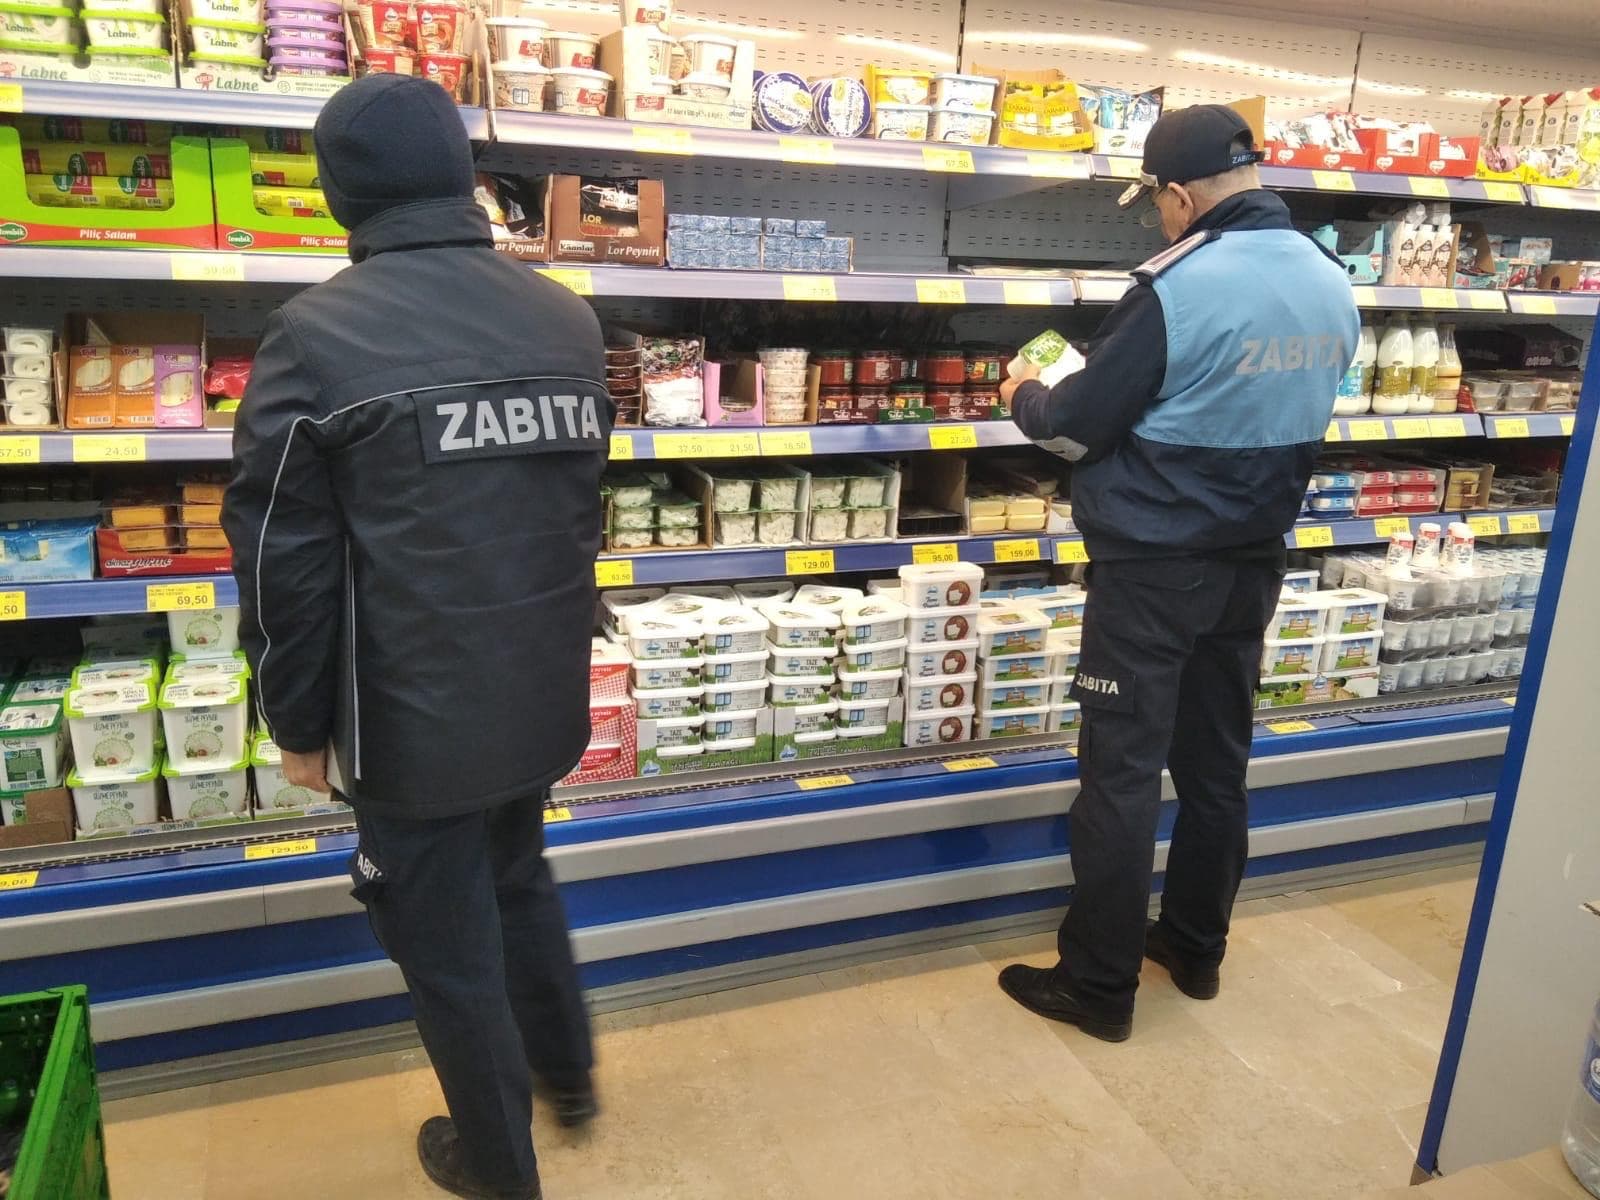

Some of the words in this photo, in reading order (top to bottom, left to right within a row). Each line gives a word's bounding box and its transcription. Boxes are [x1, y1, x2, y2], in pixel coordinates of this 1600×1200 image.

[107, 29, 137, 38] Labne
[210, 38, 239, 49] Labne
[21, 65, 69, 81] Labne
[216, 76, 259, 92] Labne
[583, 214, 602, 225] LOR
[80, 228, 102, 242] Piliç
[104, 229, 137, 241] Salam
[301, 236, 322, 248] Piliç
[508, 240, 544, 256] Peyniri
[608, 245, 624, 256] Lor
[626, 246, 660, 259] Peyniri
[437, 395, 602, 452] ZABITA
[1076, 672, 1119, 695] ZABITA
